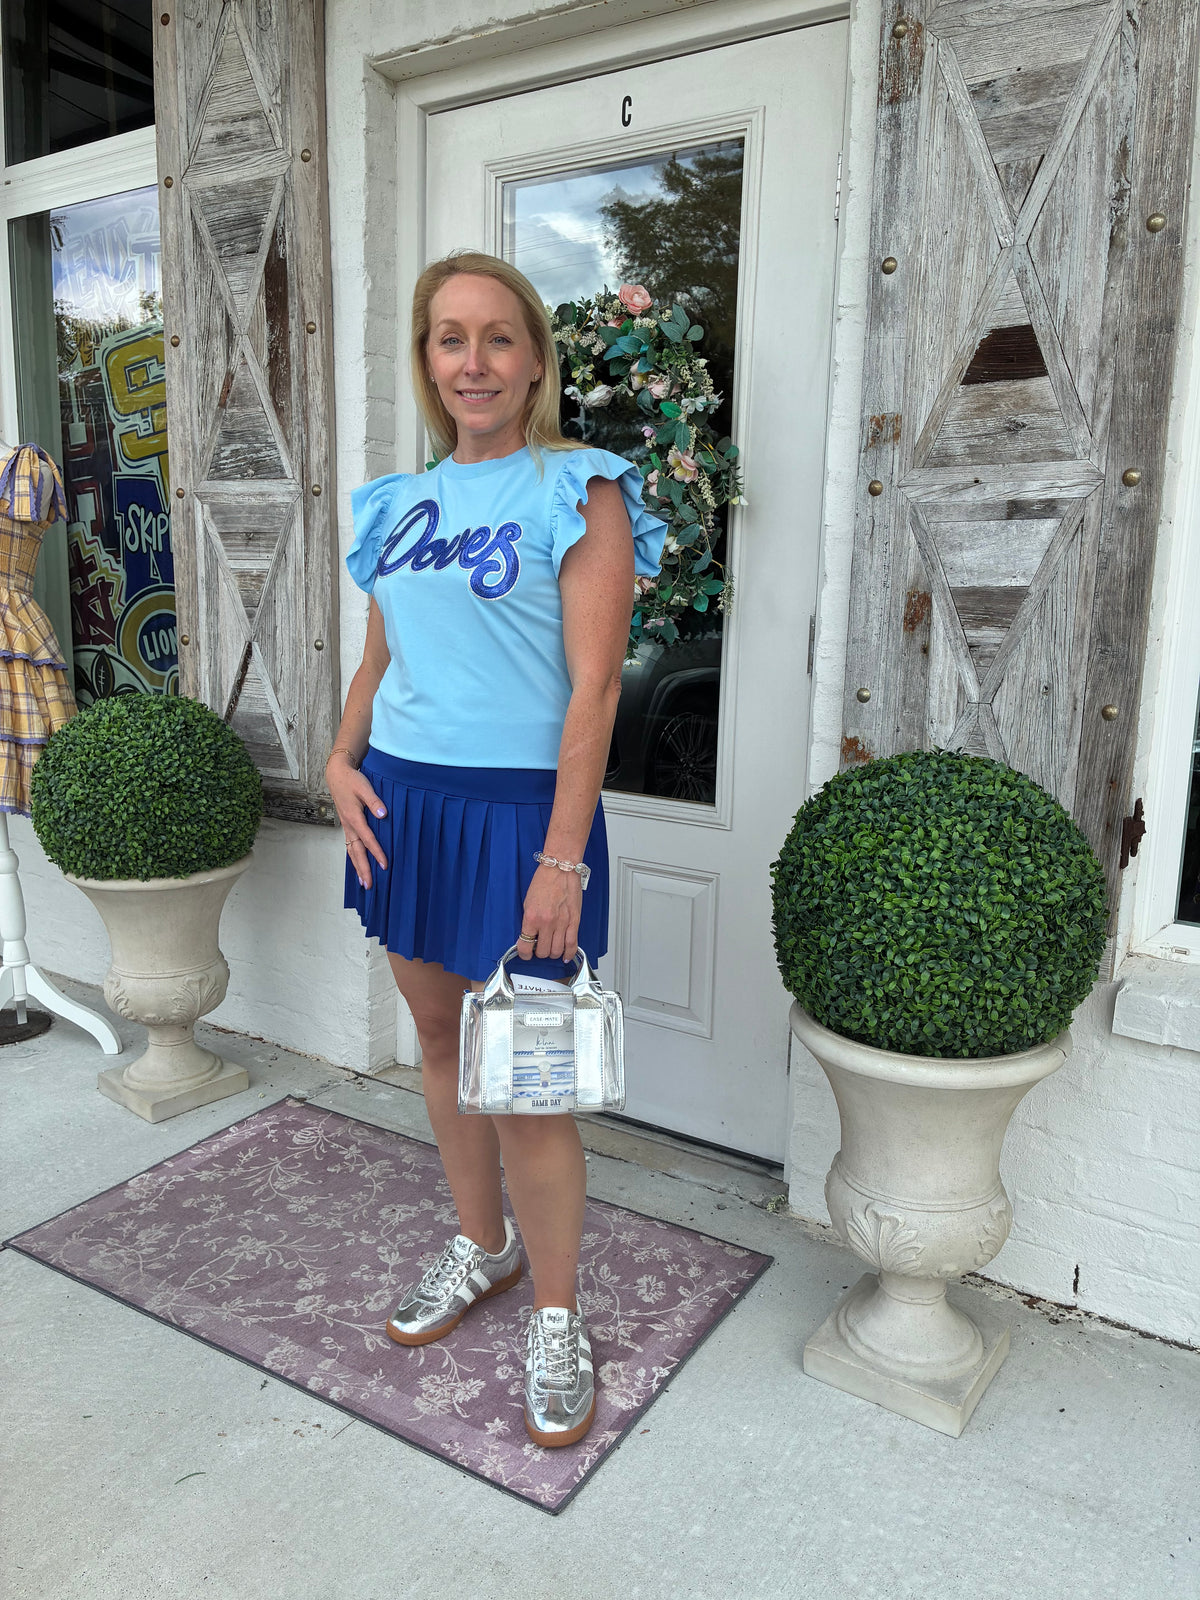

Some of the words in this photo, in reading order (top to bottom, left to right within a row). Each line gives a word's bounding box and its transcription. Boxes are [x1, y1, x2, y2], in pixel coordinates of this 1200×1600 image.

[622, 95, 632, 127] C
[125, 503, 174, 554] SKIP
[531, 1099, 549, 1107] GAME
[550, 1098, 562, 1106] DAY
